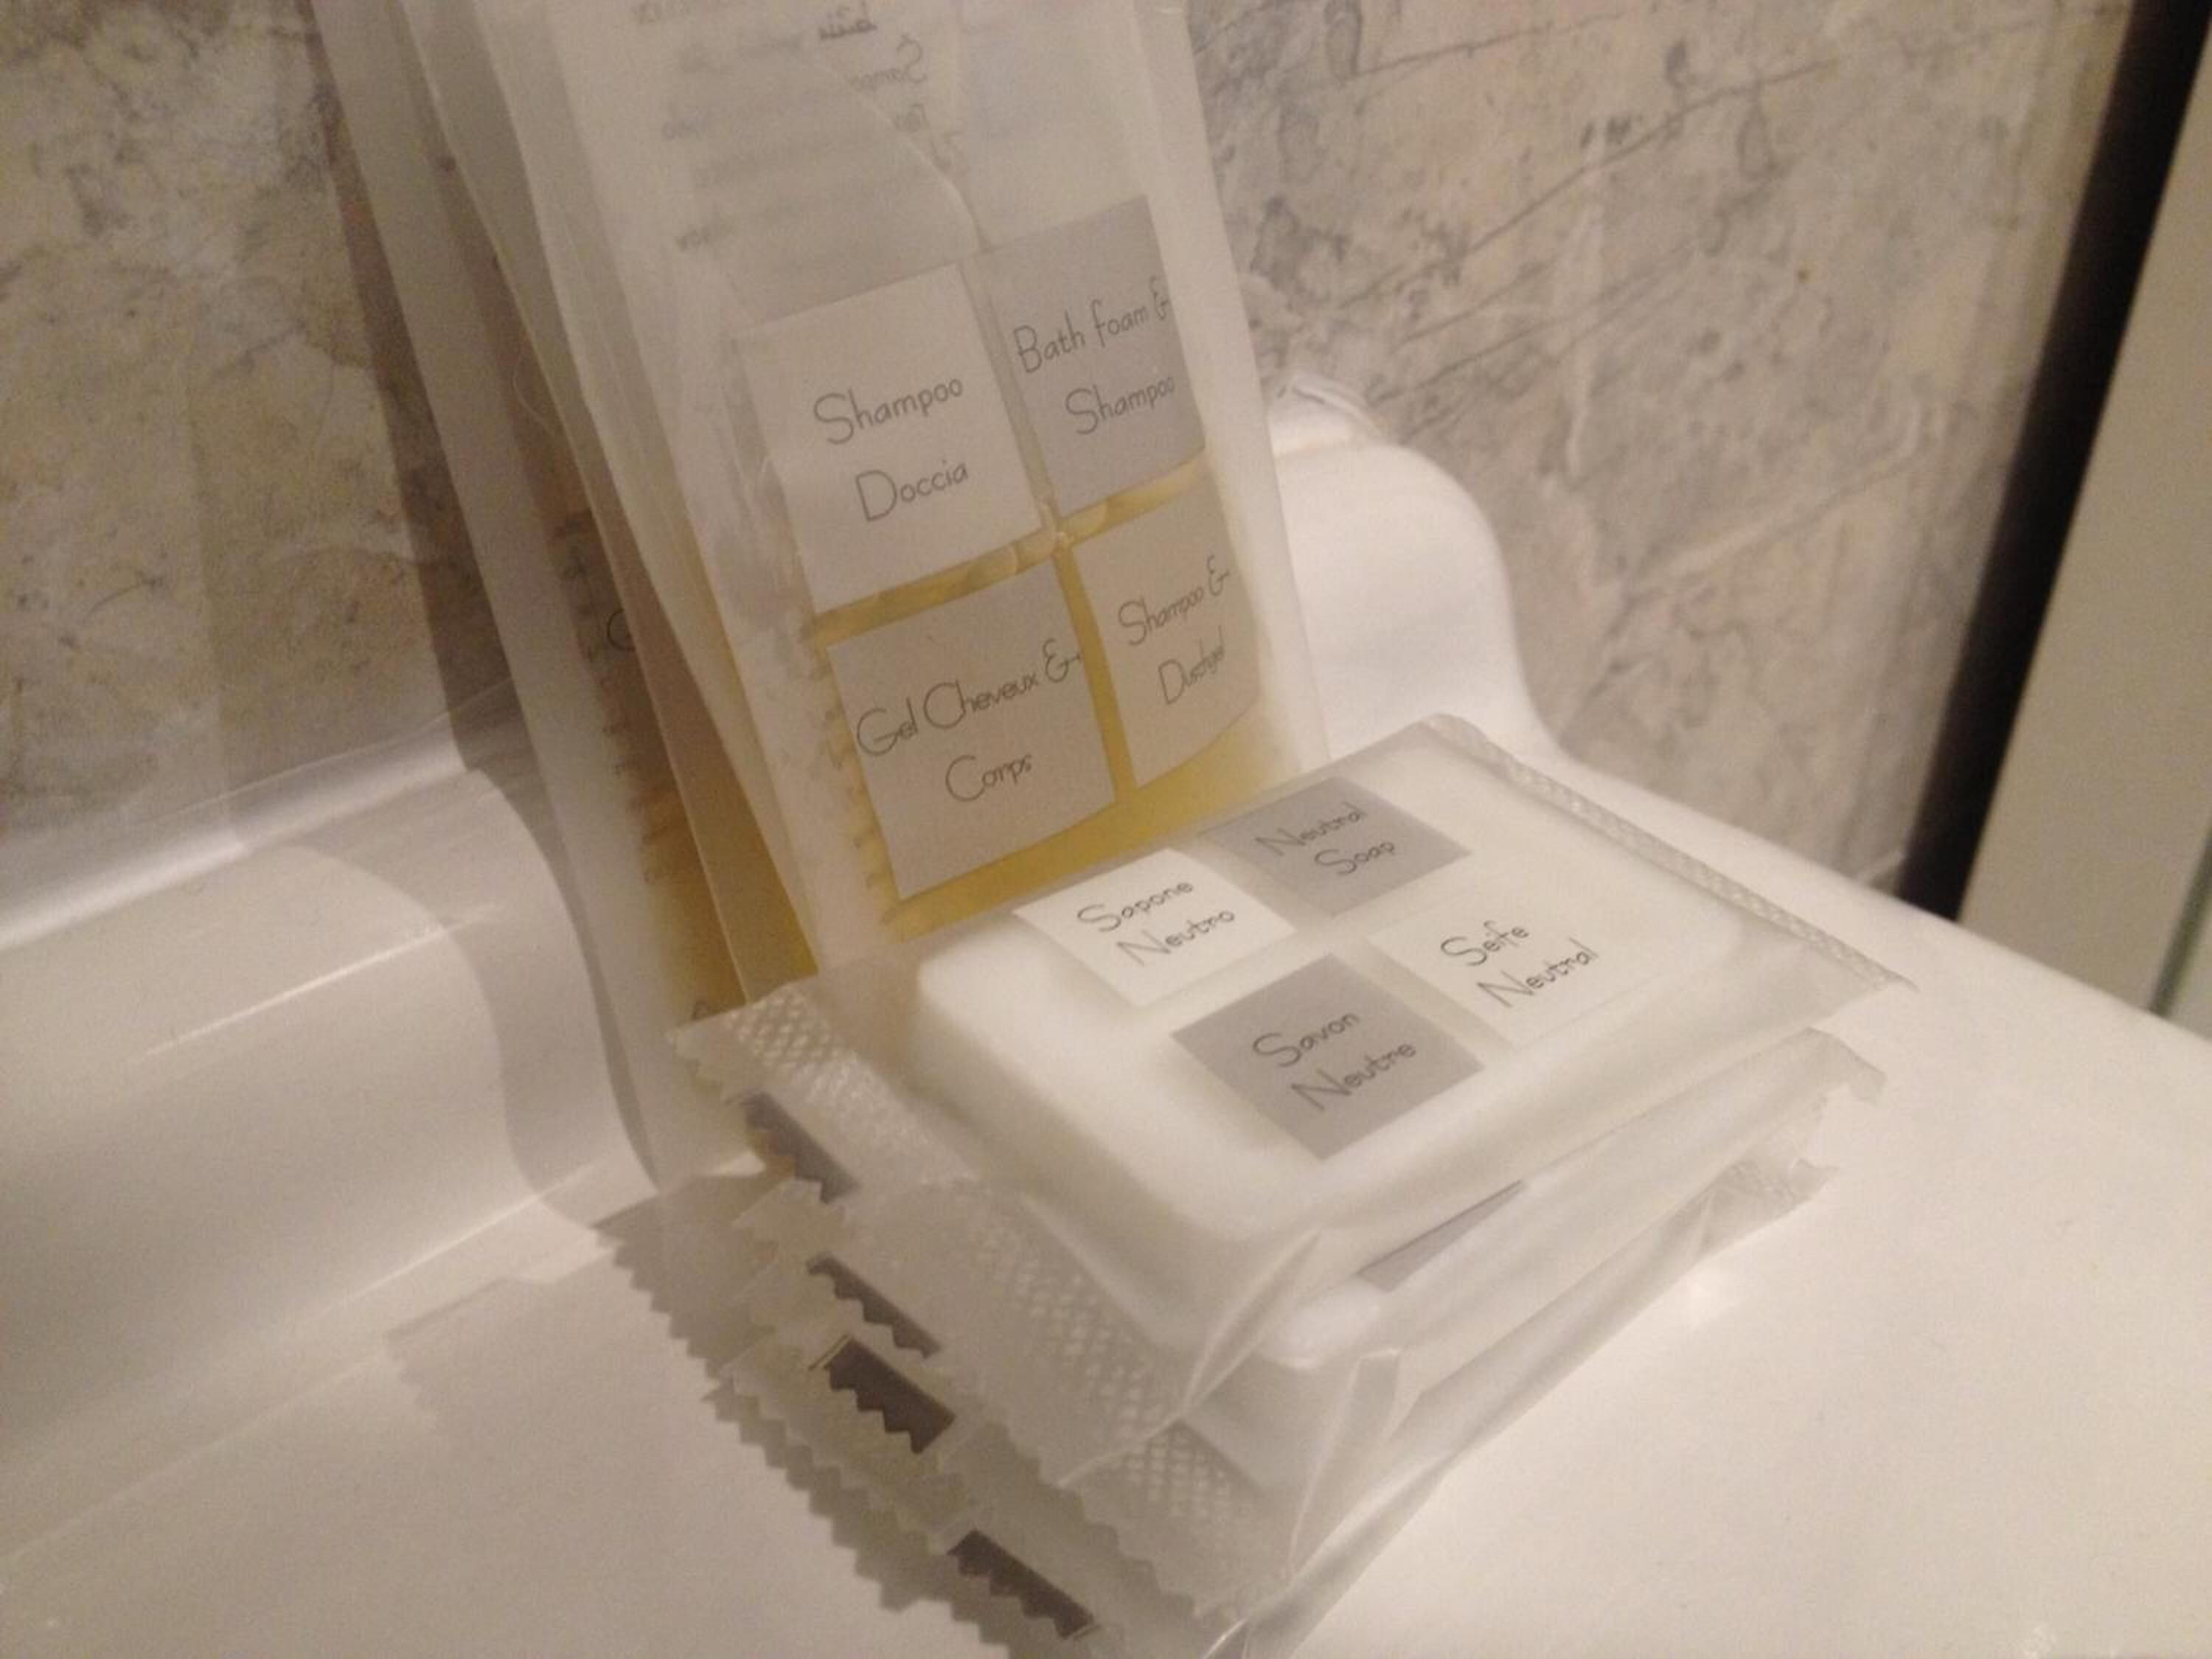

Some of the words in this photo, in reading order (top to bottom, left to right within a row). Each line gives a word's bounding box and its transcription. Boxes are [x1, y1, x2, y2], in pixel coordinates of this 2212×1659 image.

[1014, 310, 1085, 373] Bath
[1091, 299, 1149, 348] foam
[813, 378, 964, 444] Shampoo
[1065, 376, 1175, 435] Shampoo
[855, 460, 969, 522] Doccia
[1118, 586, 1204, 646] Shampoo
[856, 698, 917, 757] Gel
[923, 668, 1040, 730] Cheveux
[946, 754, 1032, 802] Corps
[1255, 802, 1368, 858] Neutral
[1314, 839, 1396, 877] Soap
[1077, 879, 1194, 933] Sapone
[1116, 909, 1236, 967] Neutro
[1441, 919, 1530, 967] Seife
[1476, 937, 1599, 1010] Neutral
[1253, 1010, 1361, 1068] Savon
[1290, 1040, 1416, 1110] Neutre
